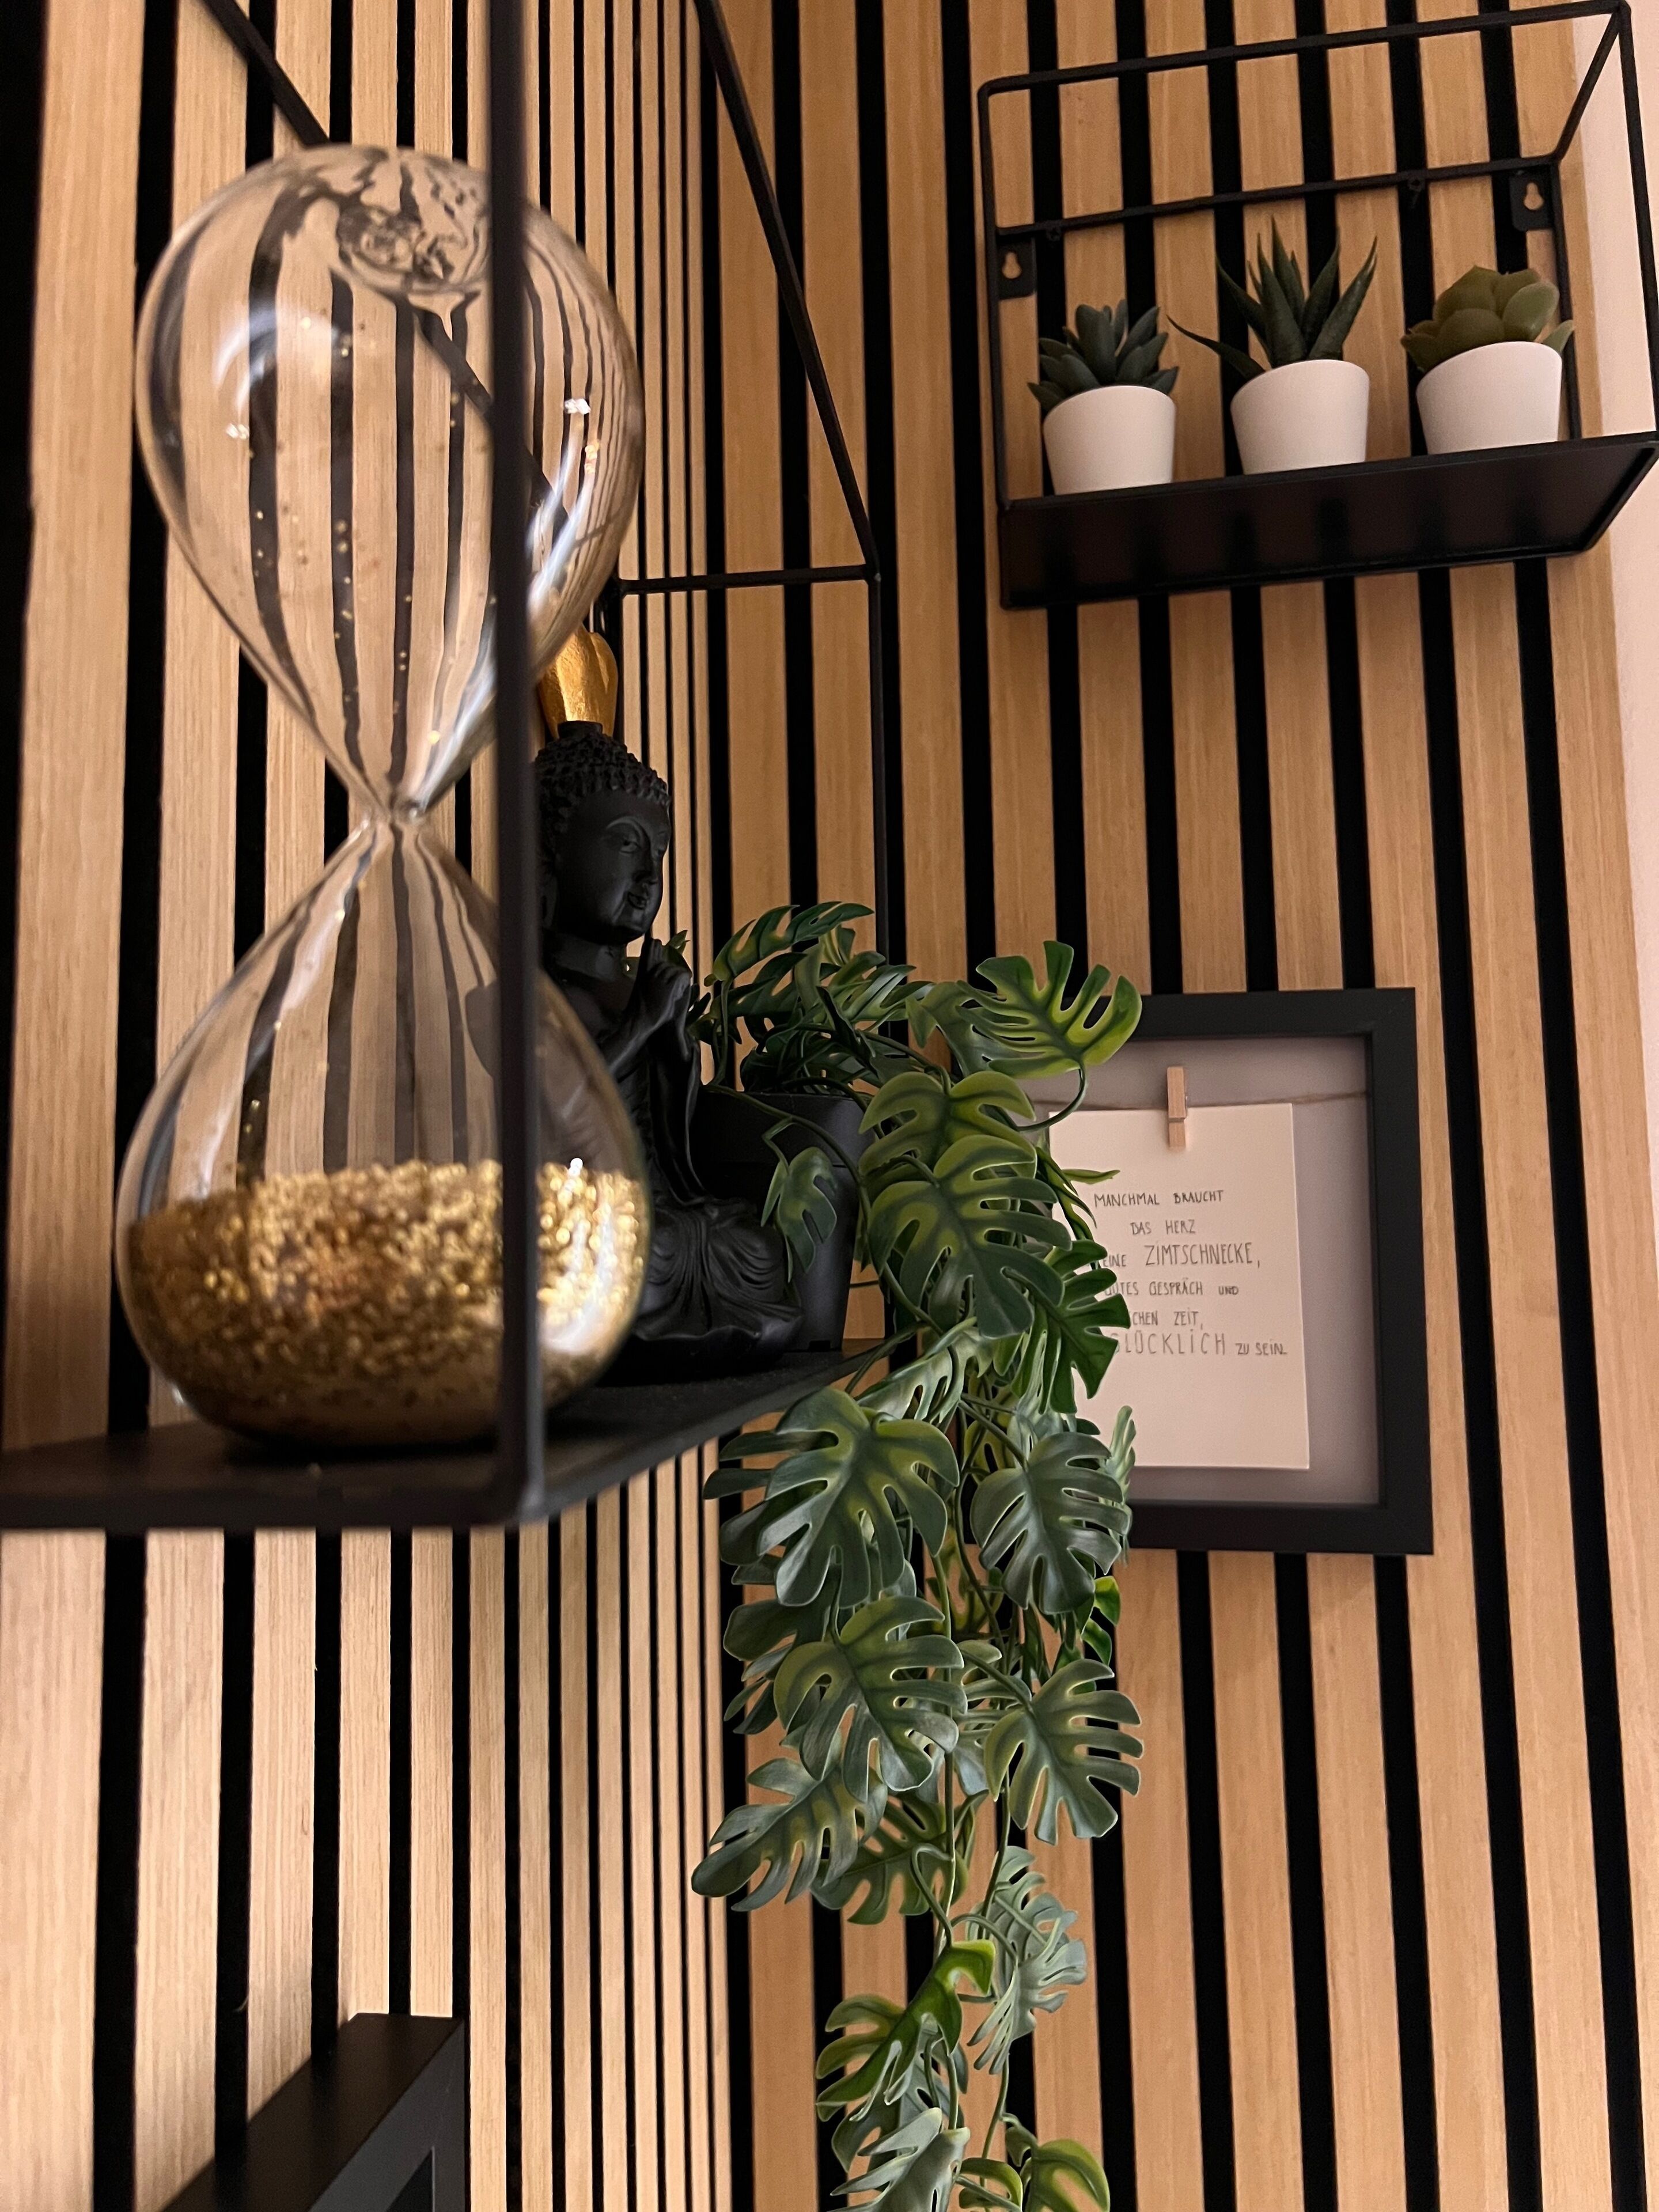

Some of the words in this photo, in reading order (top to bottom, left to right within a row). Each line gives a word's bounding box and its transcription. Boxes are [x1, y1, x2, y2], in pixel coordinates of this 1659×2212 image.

[1094, 1192, 1160, 1207] MANCHMAL
[1173, 1190, 1224, 1203] BRAUCHT
[1130, 1222, 1152, 1235] DAS
[1165, 1219, 1195, 1234] HERZ
[1143, 1241, 1260, 1268] ZIMTSCHNECKE,
[1149, 1277, 1203, 1296] GESPRÄCH
[1218, 1285, 1238, 1295] UND
[1130, 1310, 1158, 1325] CHEN
[1235, 1343, 1249, 1355] ZU
